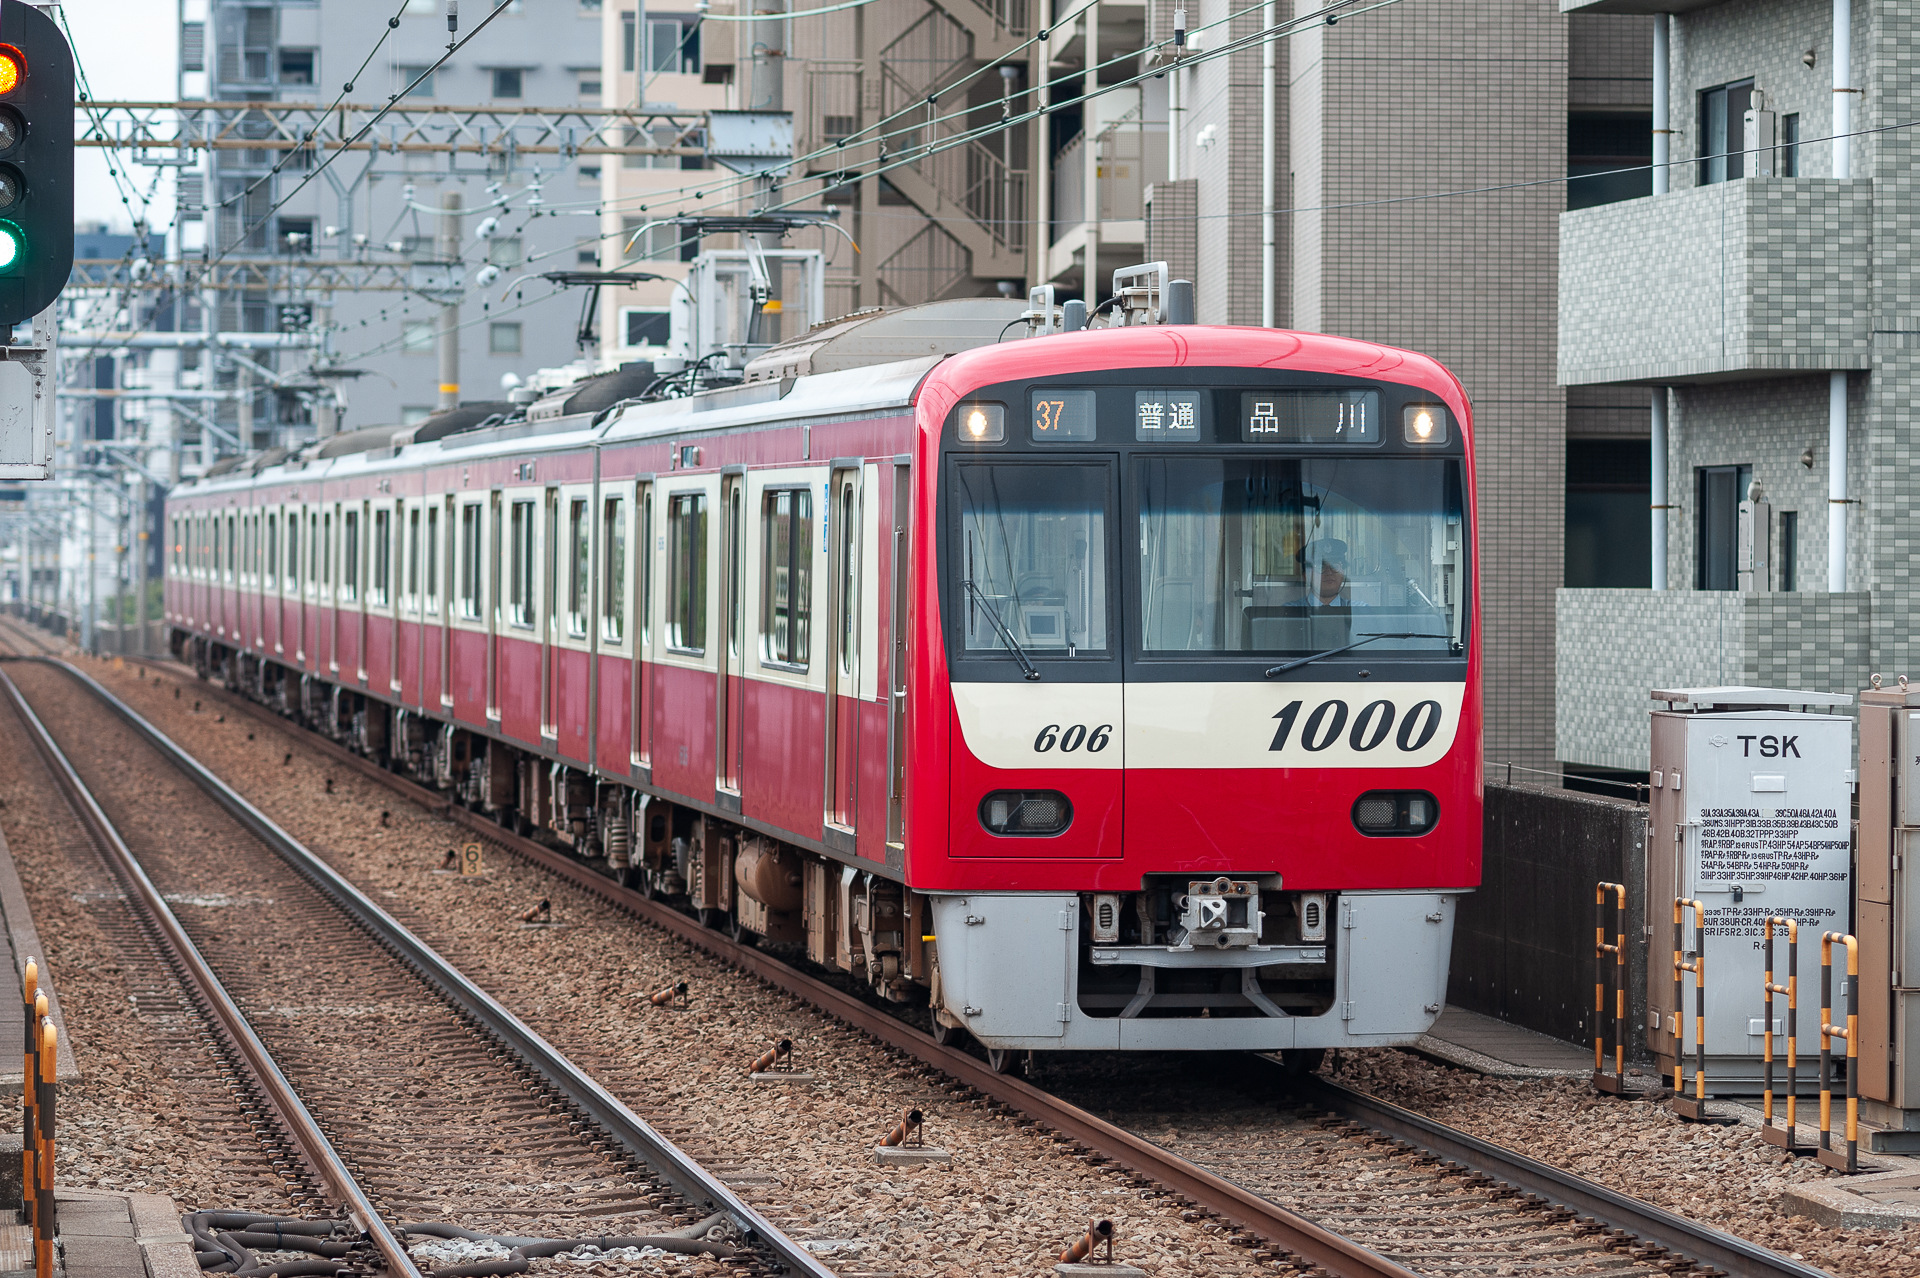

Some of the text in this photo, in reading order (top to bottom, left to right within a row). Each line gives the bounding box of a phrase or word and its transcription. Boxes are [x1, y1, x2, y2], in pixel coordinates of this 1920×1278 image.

[1036, 400, 1064, 430] 37
[1138, 401, 1195, 430] 普通
[1250, 402, 1367, 434] 品川
[1033, 724, 1113, 753] 606
[1268, 699, 1442, 752] 1000
[1736, 735, 1802, 758] TSK
[465, 845, 479, 863] 6
[468, 863, 477, 874] 3
